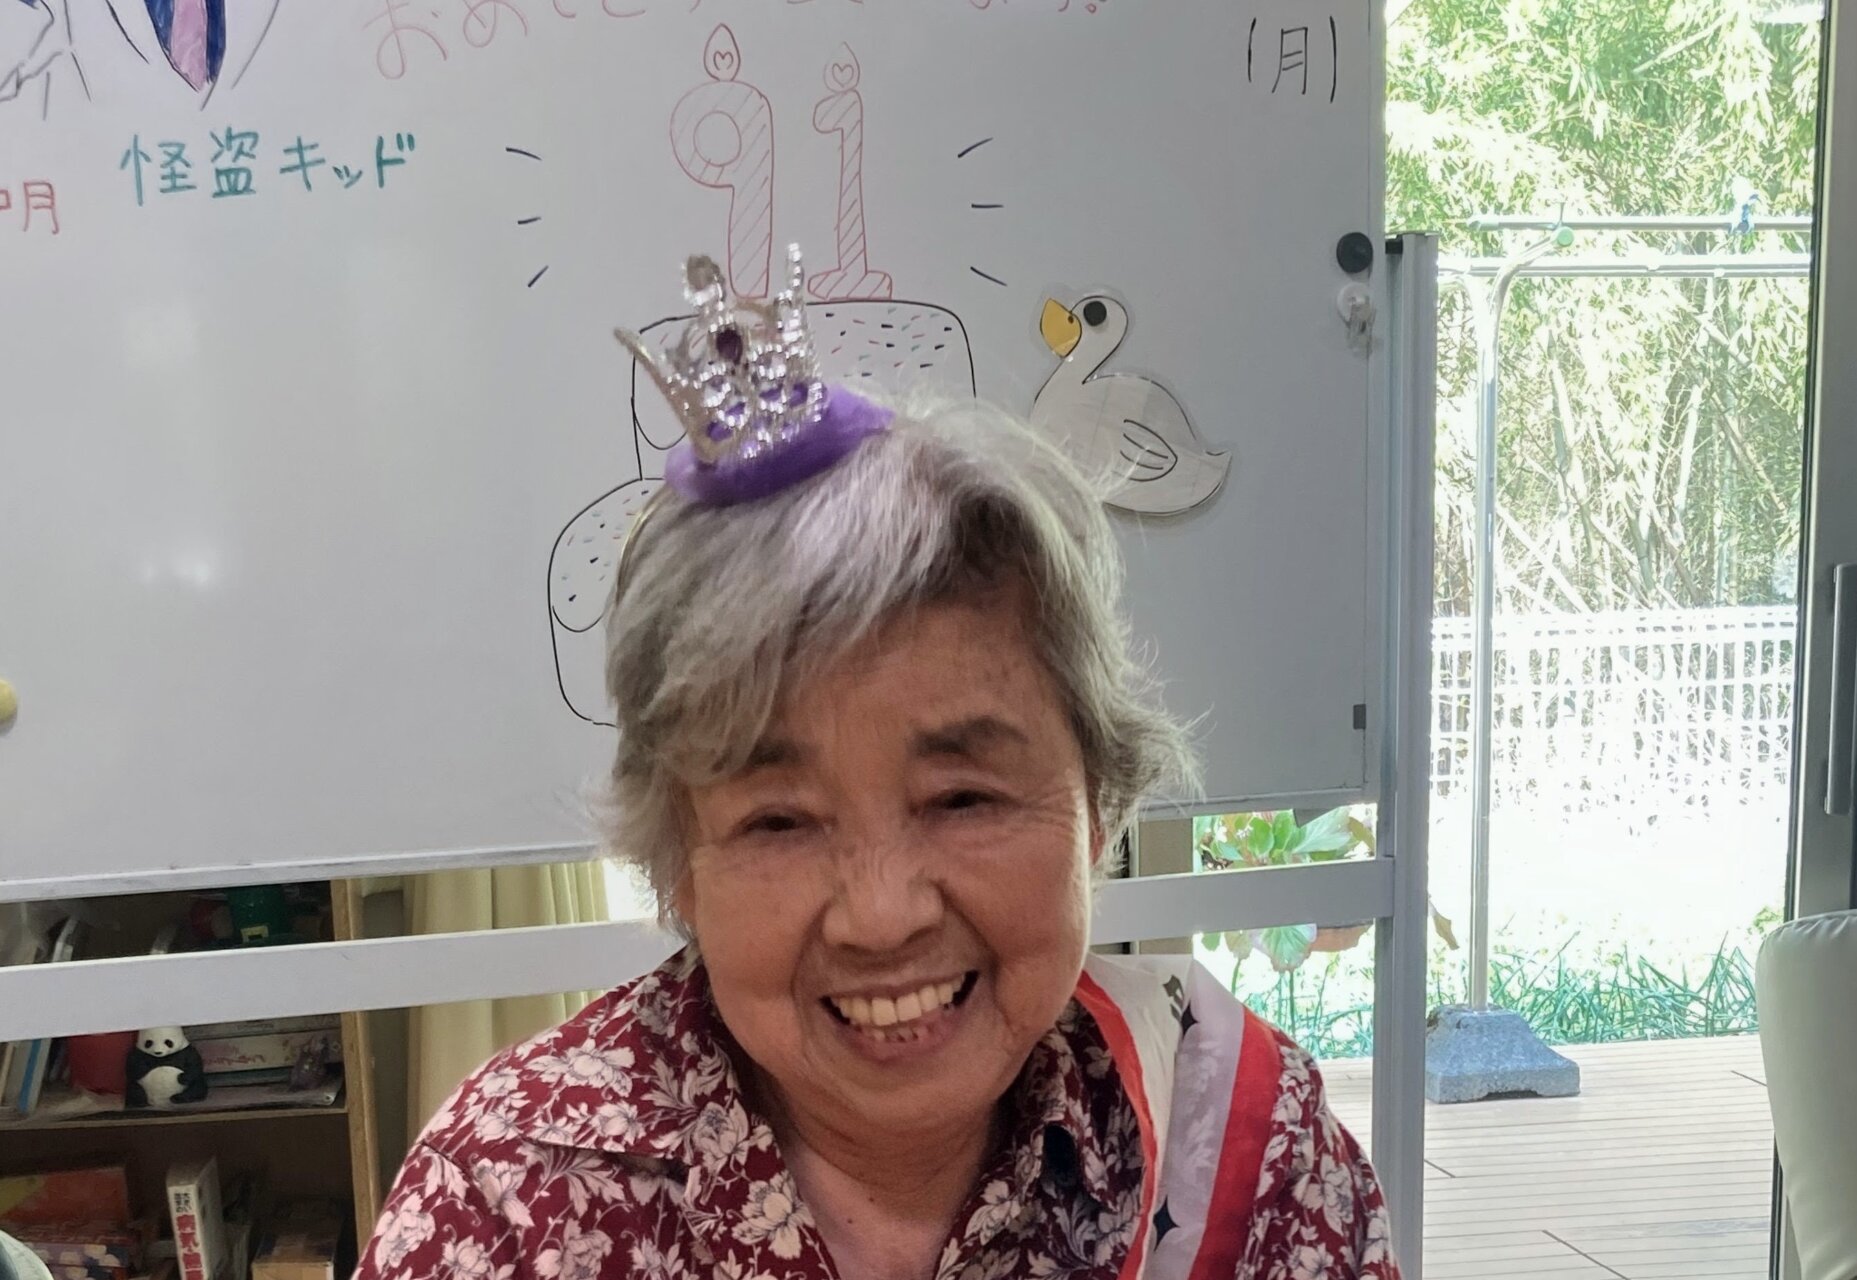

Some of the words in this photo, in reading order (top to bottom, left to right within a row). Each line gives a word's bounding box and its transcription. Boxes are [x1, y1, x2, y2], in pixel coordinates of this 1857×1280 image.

[119, 127, 416, 206] 怪盗キッド
